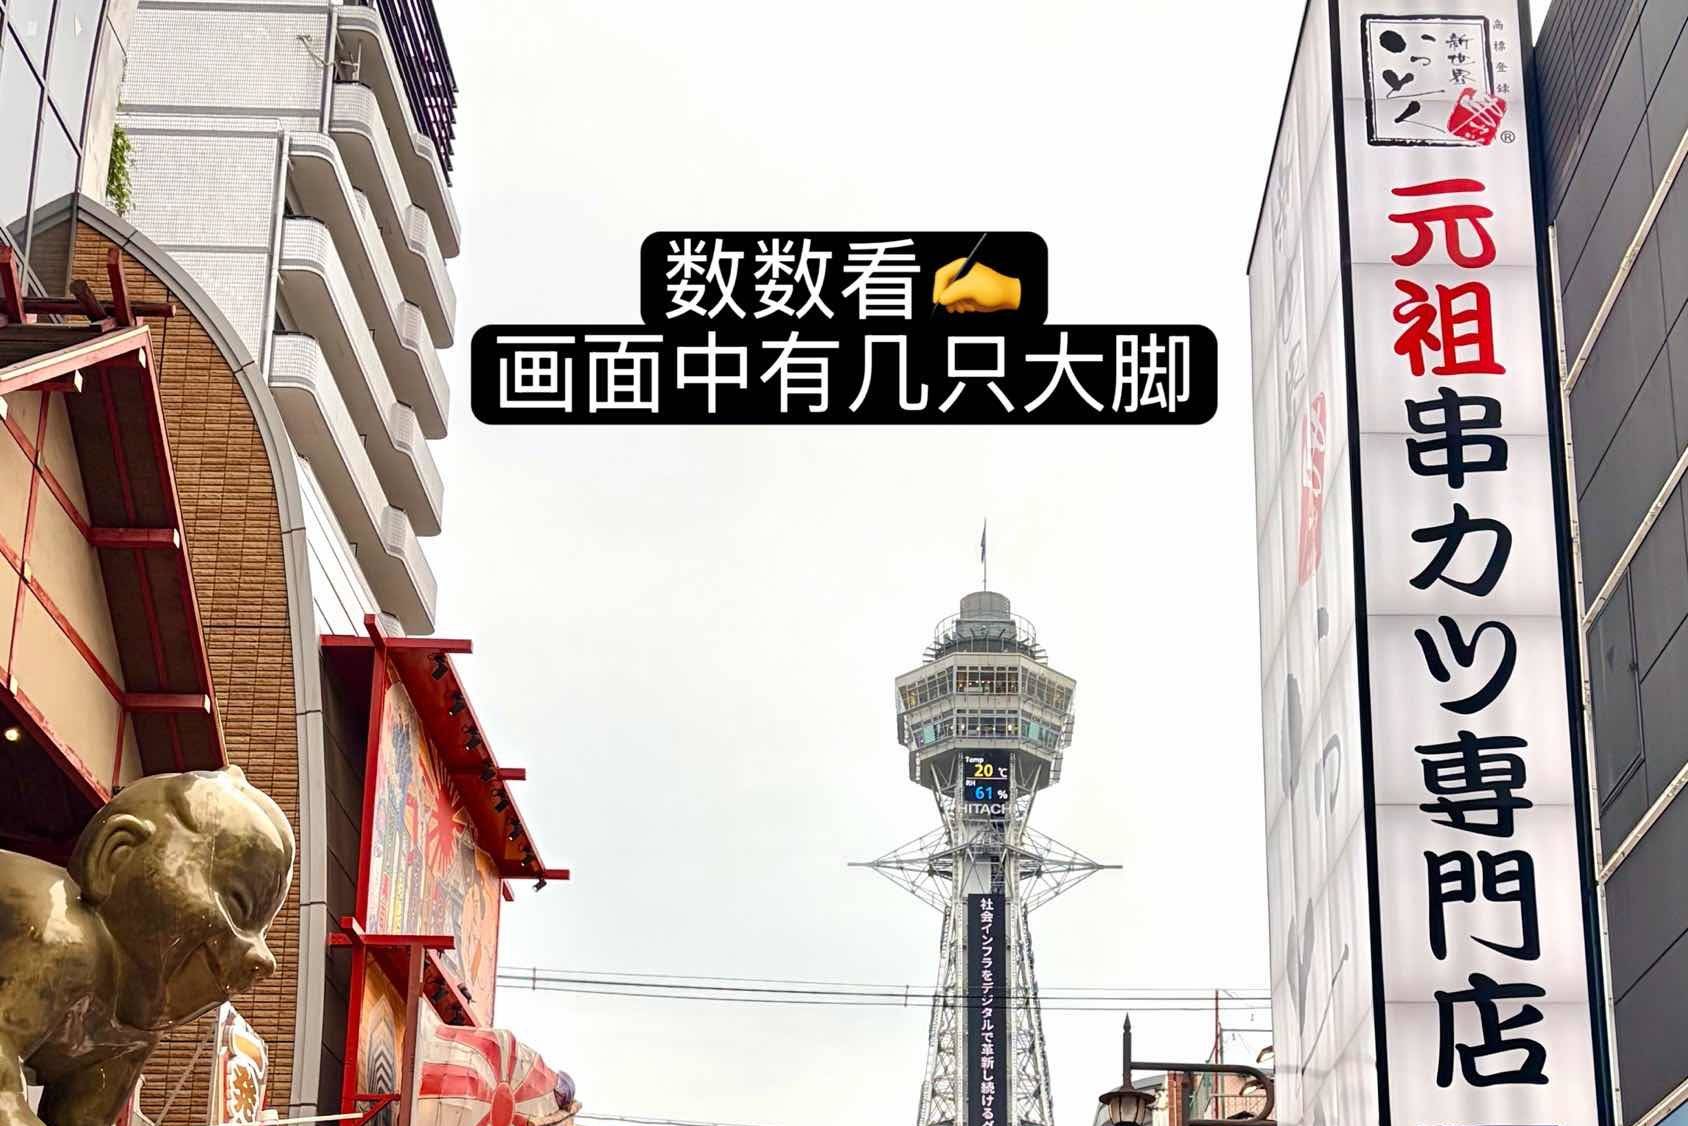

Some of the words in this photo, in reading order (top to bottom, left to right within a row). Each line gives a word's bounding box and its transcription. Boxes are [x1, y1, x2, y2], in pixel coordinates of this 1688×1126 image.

[1388, 178, 1549, 1088] 元祖串カツ専門店
[974, 764, 993, 777] 20
[975, 786, 993, 800] 61
[961, 803, 1012, 815] HITACH
